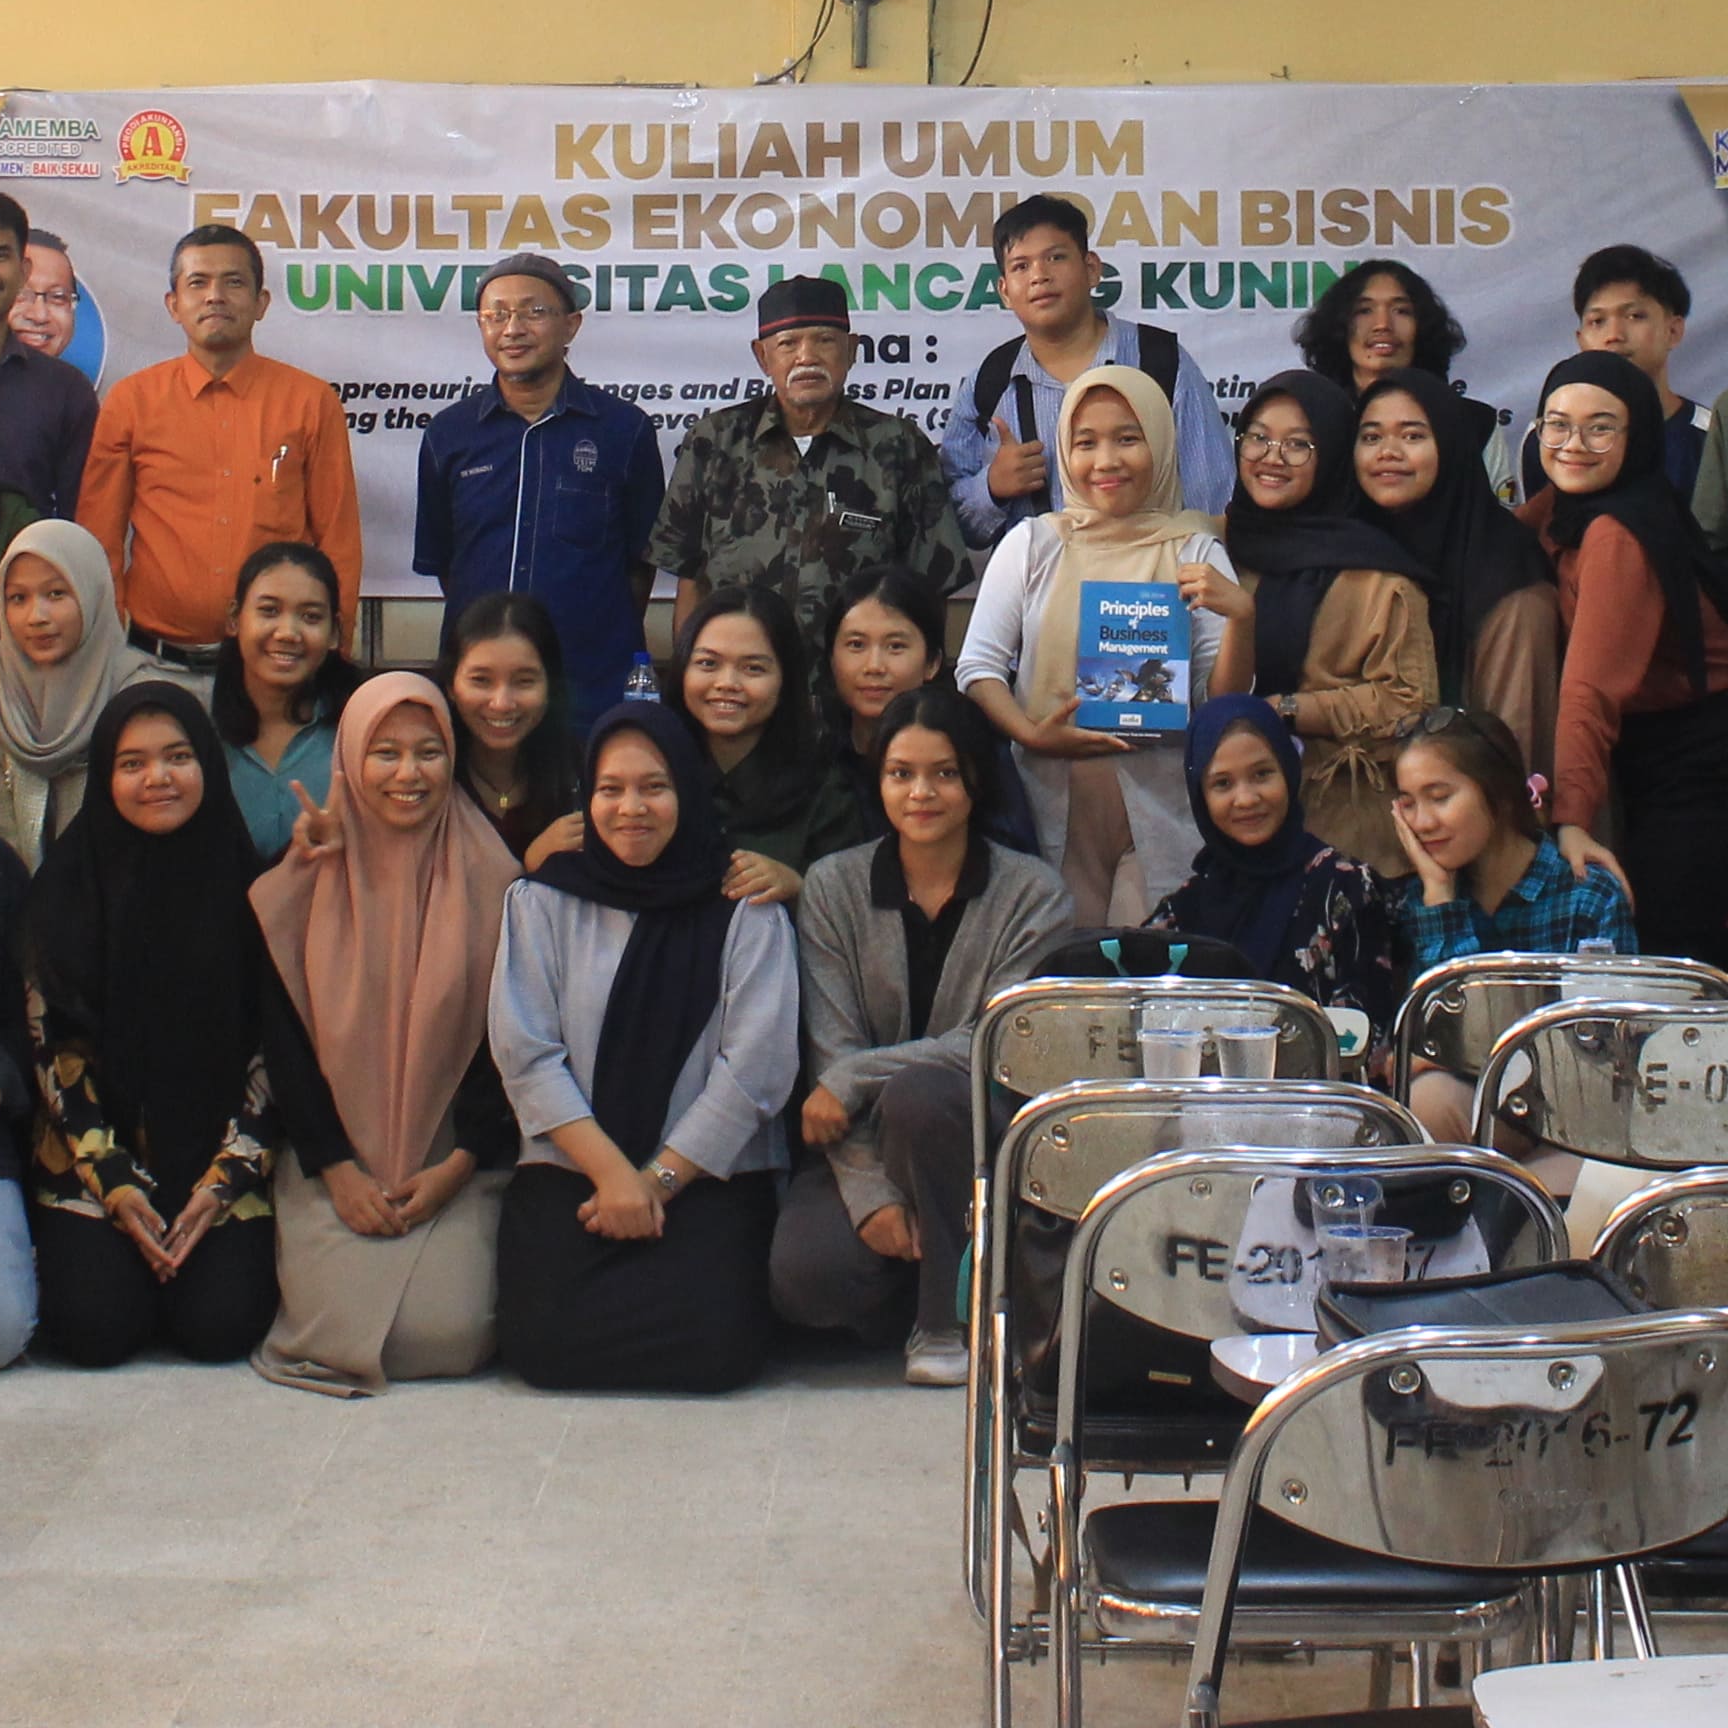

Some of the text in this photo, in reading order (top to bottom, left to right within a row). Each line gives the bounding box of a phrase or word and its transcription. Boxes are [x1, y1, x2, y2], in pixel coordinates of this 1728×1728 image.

[142, 126, 163, 157] A
[555, 120, 1145, 180] KULIAH UMUM
[32, 162, 60, 175] BAIK
[62, 162, 99, 176] SEKALI
[193, 193, 612, 250] FAKULTAS
[1241, 186, 1512, 247] BISNIS
[680, 377, 741, 400] and
[883, 376, 951, 400] Plan
[384, 407, 433, 430] the
[1099, 599, 1170, 619] Principles
[1099, 624, 1169, 642] Business
[1098, 641, 1169, 656] Management
